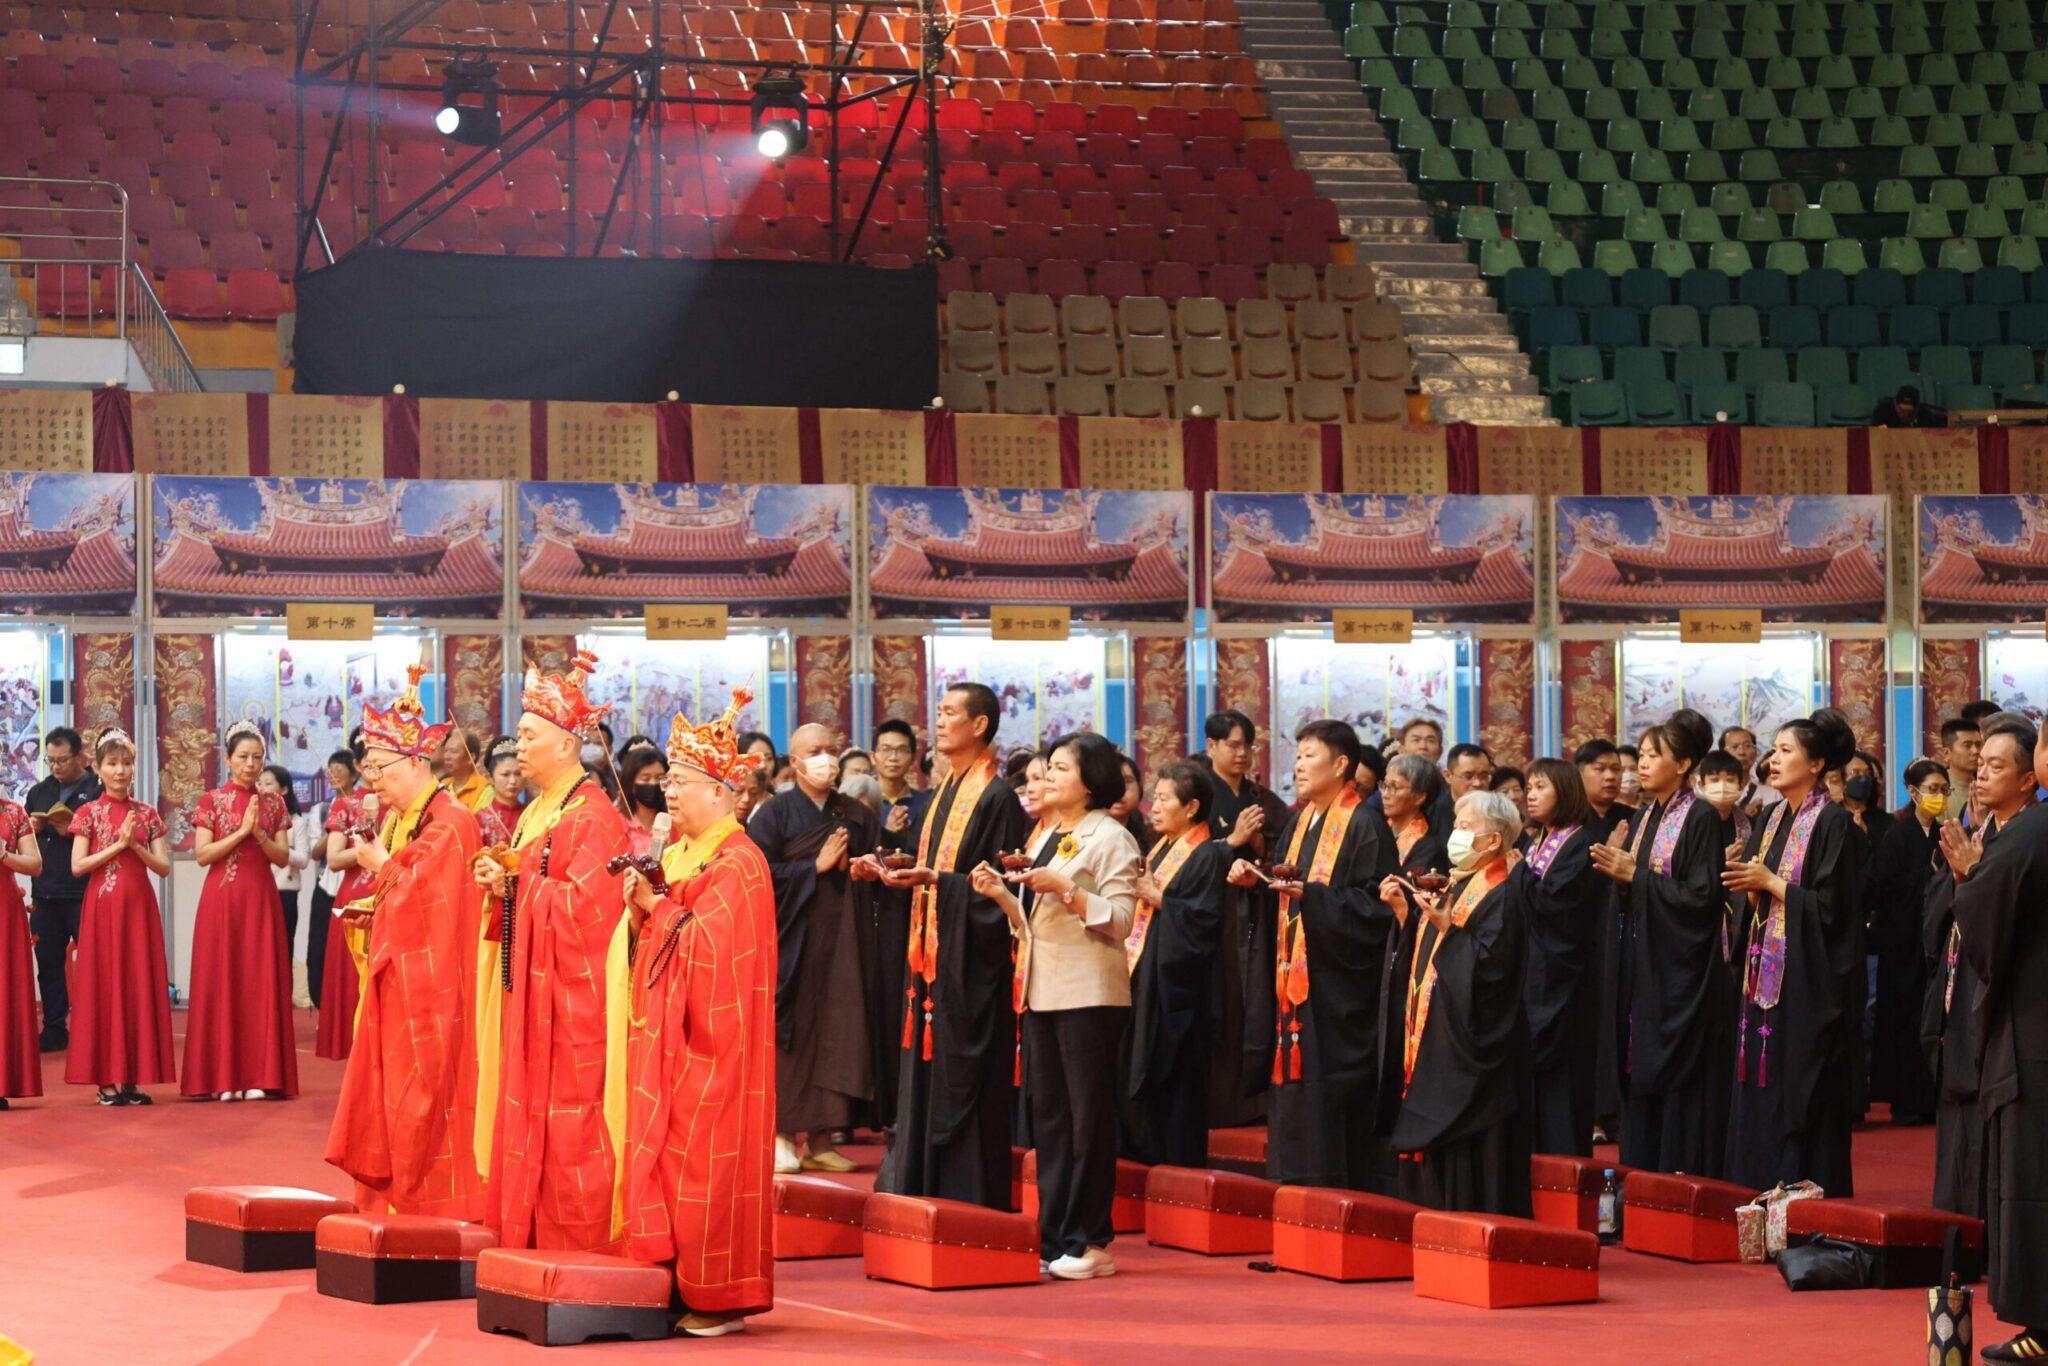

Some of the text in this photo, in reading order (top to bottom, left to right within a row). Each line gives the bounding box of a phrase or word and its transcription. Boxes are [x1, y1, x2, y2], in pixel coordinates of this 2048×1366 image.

[305, 616, 357, 629] 第十席
[656, 617, 717, 629] 第十二席
[1000, 617, 1062, 630] 第十四席
[1342, 621, 1405, 633] 第十六席
[1689, 621, 1753, 633] 第十八席
